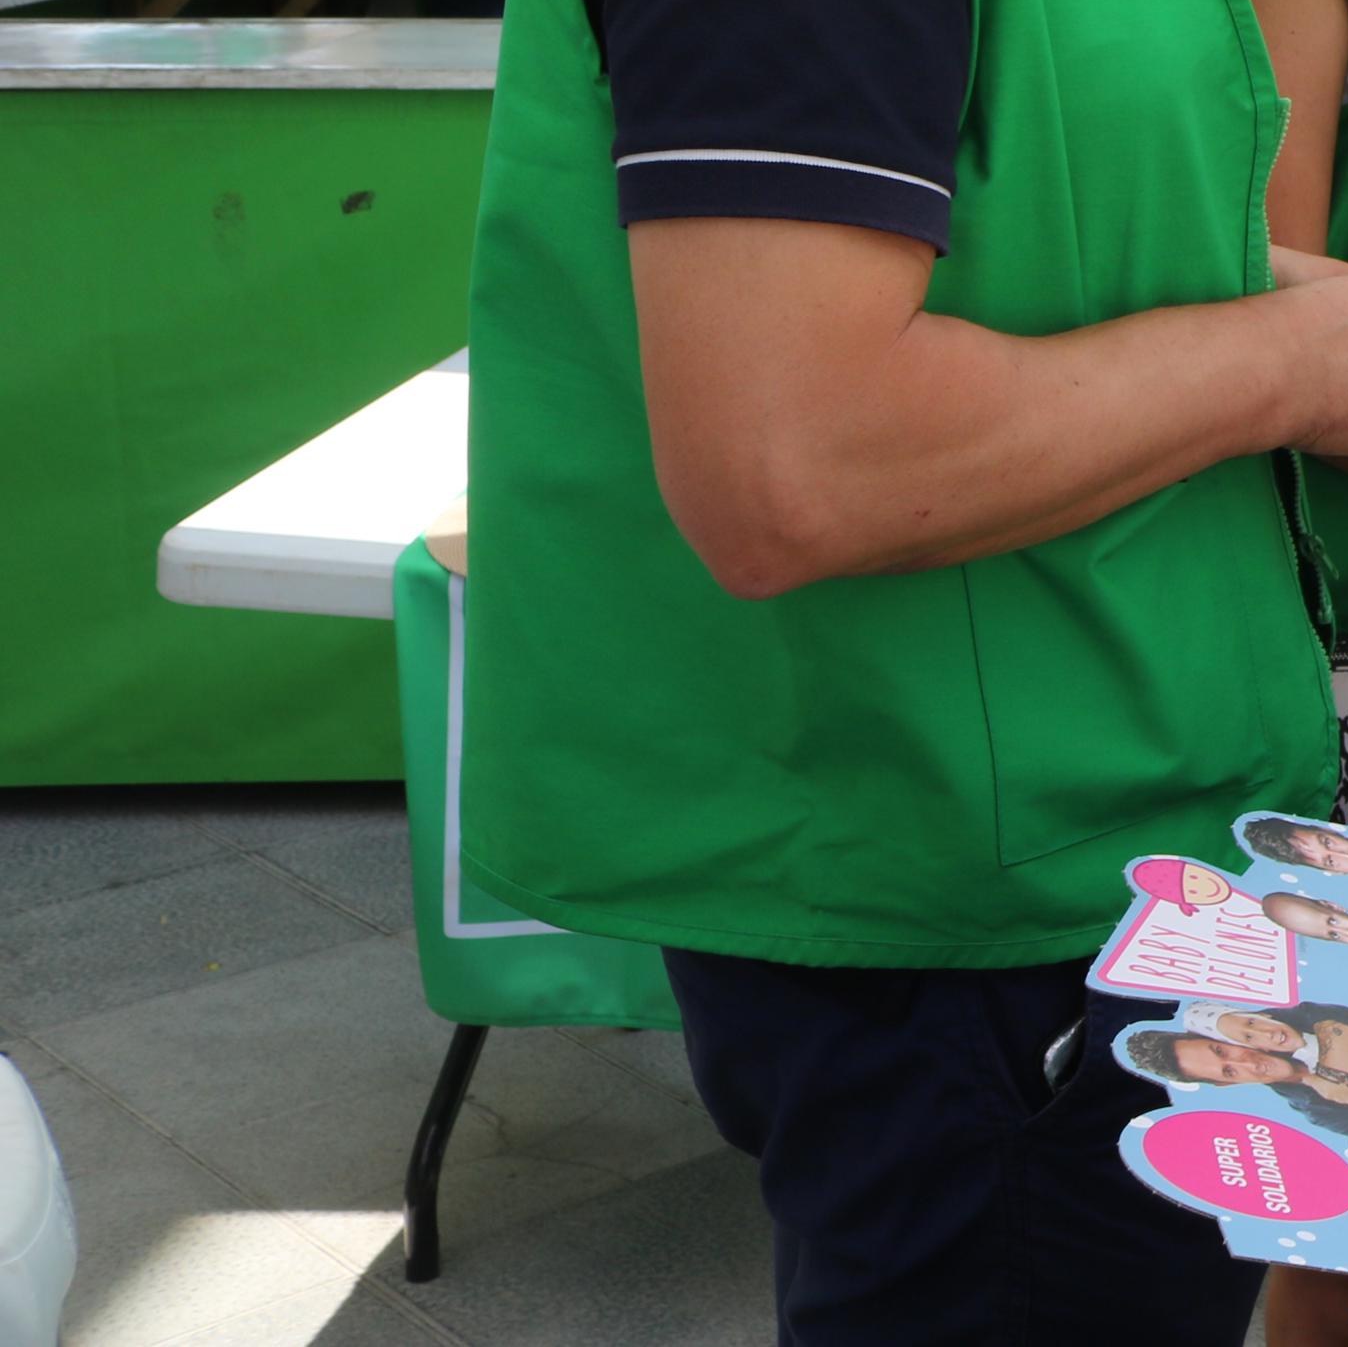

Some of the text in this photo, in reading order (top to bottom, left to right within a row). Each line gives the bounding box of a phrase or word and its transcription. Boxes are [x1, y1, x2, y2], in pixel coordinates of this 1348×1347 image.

[1128, 923, 1212, 985] BABY
[1206, 907, 1281, 997] PELONES
[1213, 1136, 1248, 1188] SUPER
[1246, 1122, 1292, 1214] SOLIDARIOS
